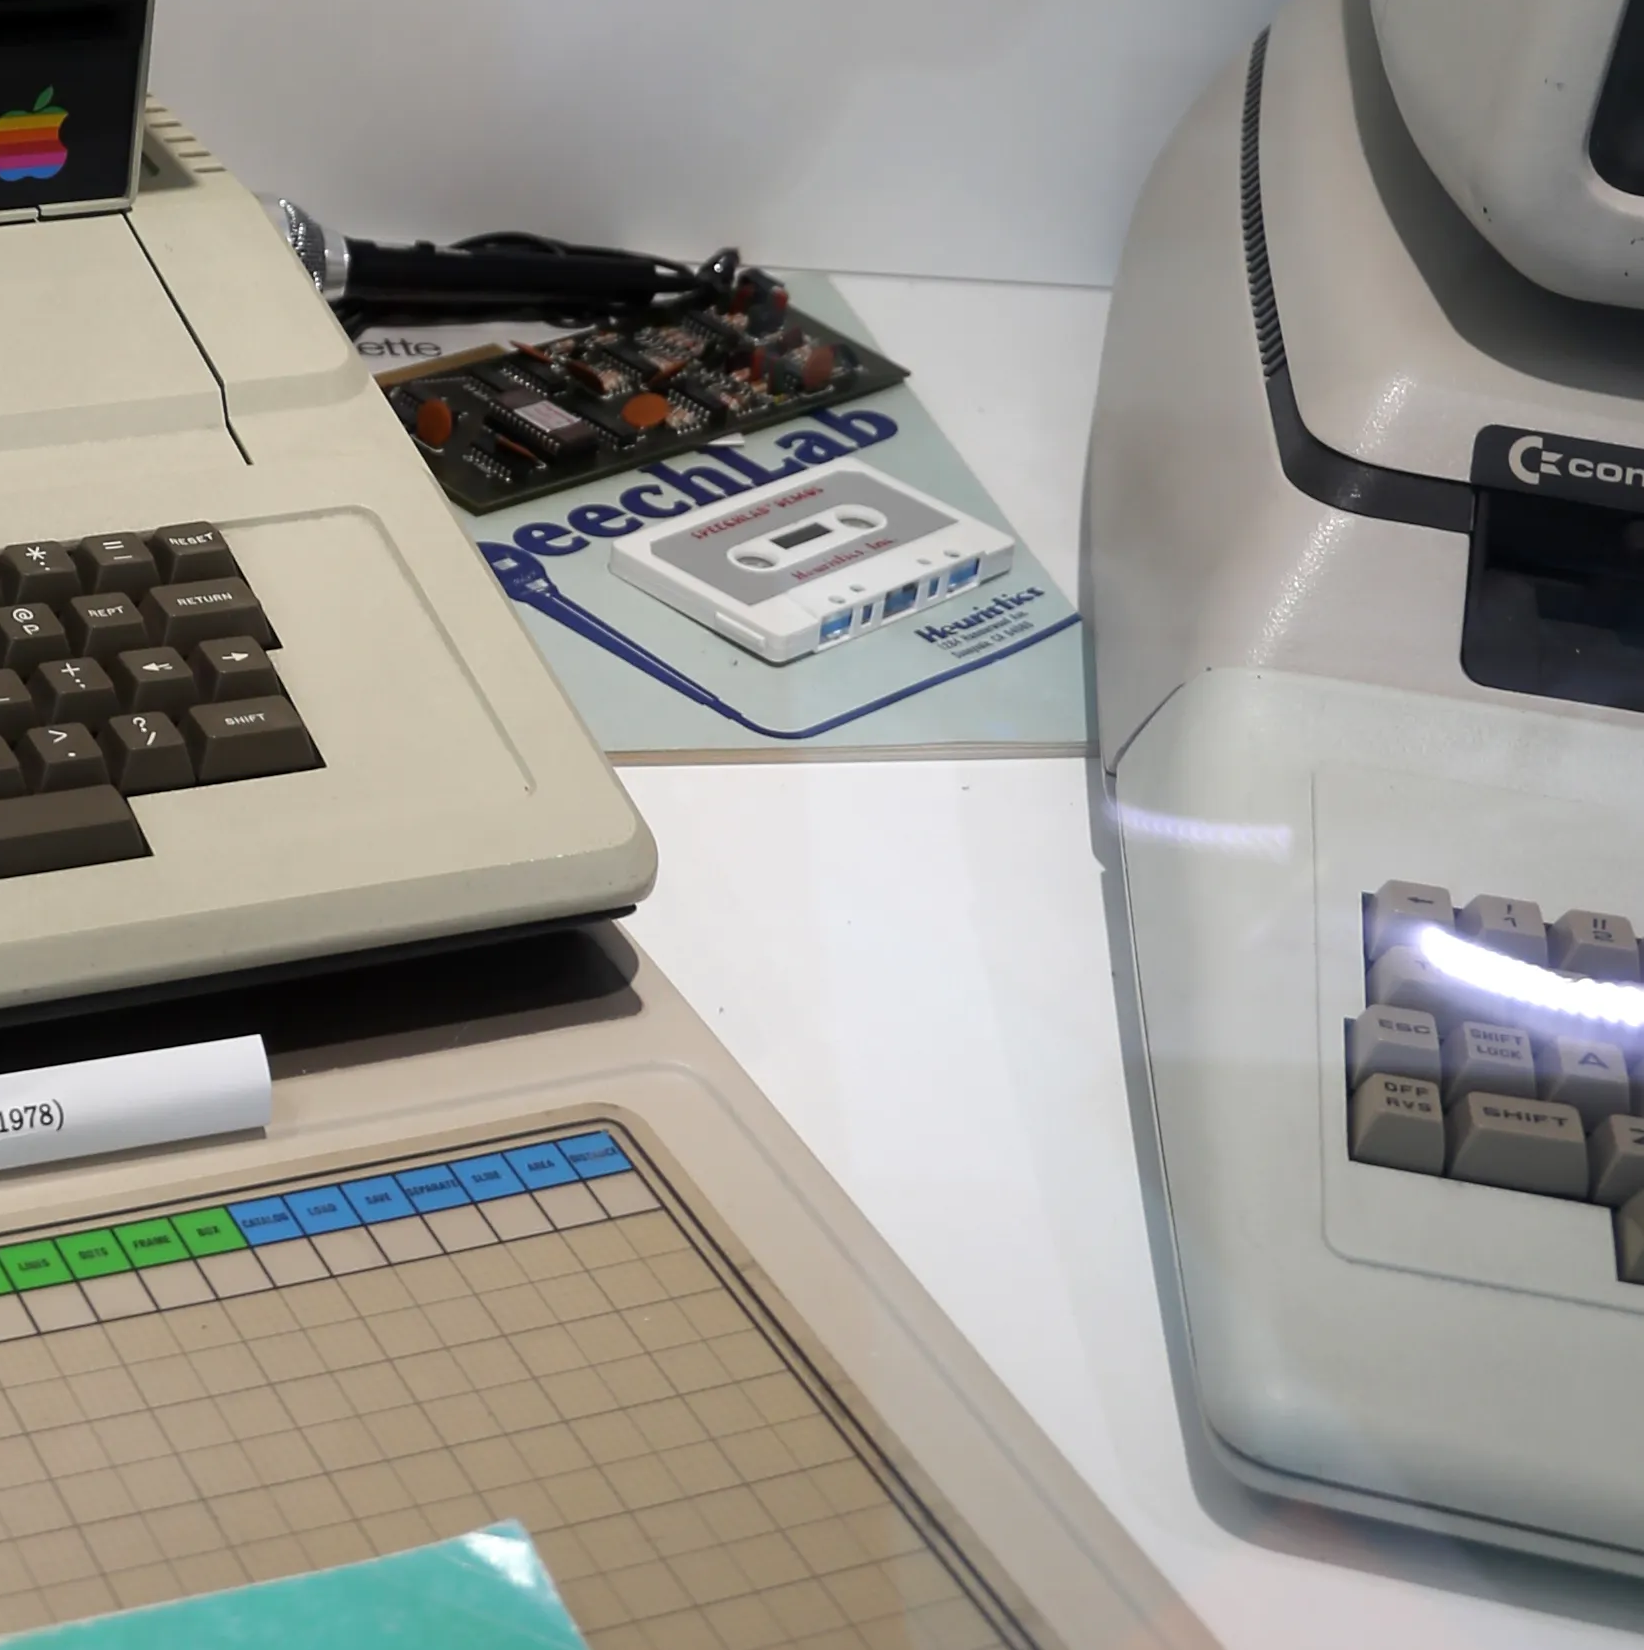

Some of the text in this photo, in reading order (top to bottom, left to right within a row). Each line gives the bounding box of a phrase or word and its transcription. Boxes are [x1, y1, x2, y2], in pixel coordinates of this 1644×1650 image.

[168, 531, 215, 548] RESET
[177, 590, 233, 607] RETURN
[224, 712, 266, 726] SHIFT
[1377, 1018, 1431, 1035] ESC
[1577, 1051, 1610, 1069] A
[1482, 1105, 1569, 1128] SHIFT
